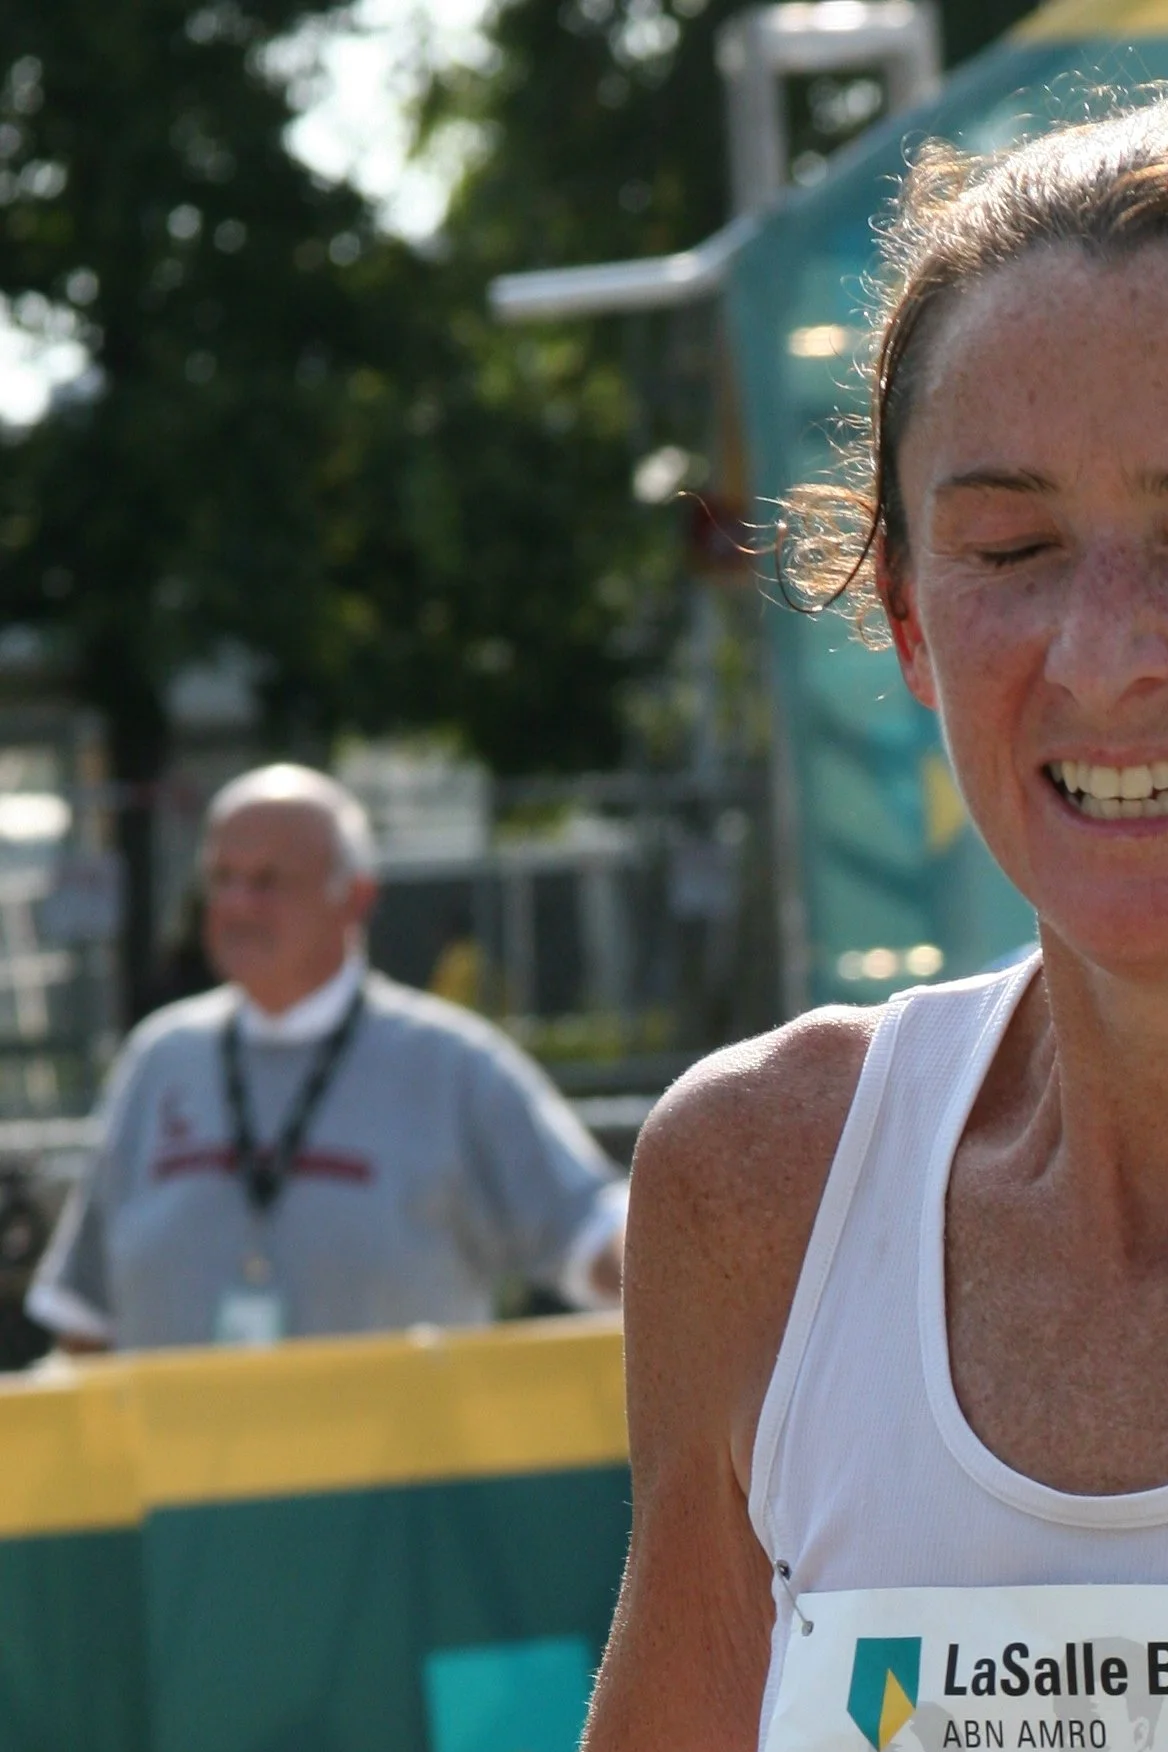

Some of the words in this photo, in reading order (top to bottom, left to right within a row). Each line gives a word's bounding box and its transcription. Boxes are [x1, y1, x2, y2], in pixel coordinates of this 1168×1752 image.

[944, 1642, 1128, 1697] LaSalle
[943, 1720, 1003, 1748] ABN
[1017, 1719, 1107, 1748] AMRO
